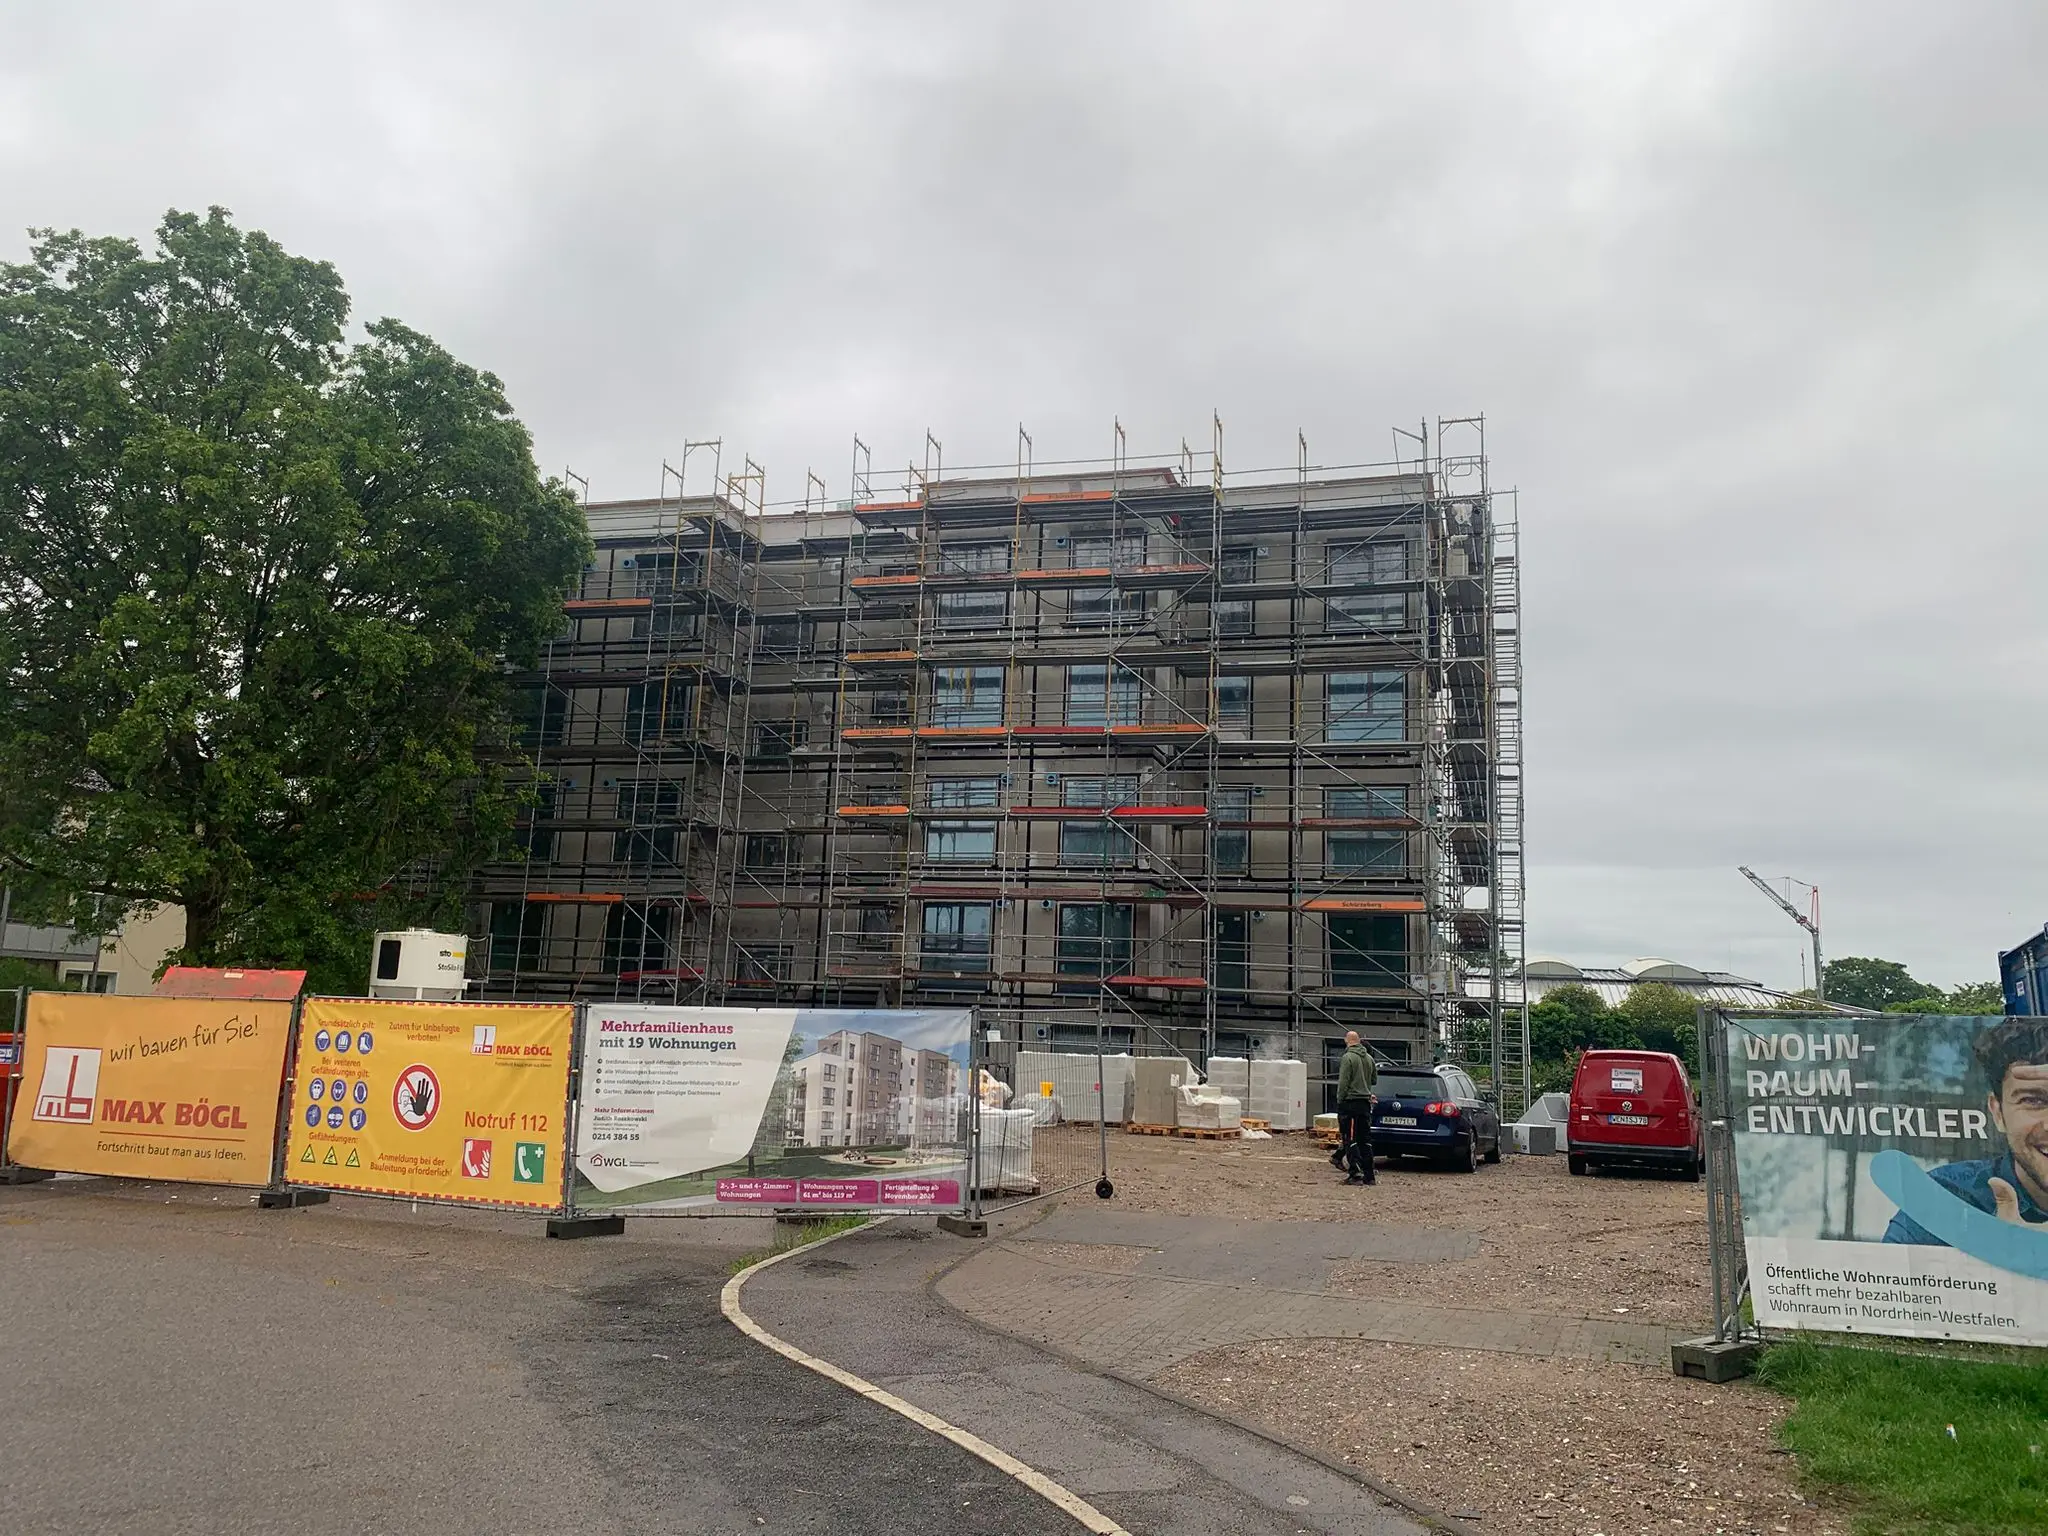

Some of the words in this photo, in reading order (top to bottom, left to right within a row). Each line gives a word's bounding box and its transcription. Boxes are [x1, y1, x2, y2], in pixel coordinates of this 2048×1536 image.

[411, 1022, 422, 1031] für
[423, 1024, 461, 1035] Unbefugte
[600, 1020, 734, 1035] Mehrfamilienhaus
[110, 1043, 135, 1062] wir
[139, 1036, 187, 1057] bauen
[193, 1024, 220, 1046] für
[224, 1015, 258, 1043] Sie!
[407, 1033, 441, 1041] verboten!
[599, 1036, 625, 1048] mit
[627, 1036, 645, 1049] 19
[648, 1037, 737, 1053] Wohnungen
[496, 1045, 521, 1055] MAX
[523, 1043, 552, 1056] BÖGL
[1743, 1033, 1876, 1062] WOHN-
[1747, 1068, 1869, 1097] RAUM-
[101, 1099, 167, 1125] MAX
[174, 1098, 248, 1129] BÖGL
[464, 1111, 516, 1130] Notruf
[521, 1114, 547, 1132] 112
[1749, 1105, 1988, 1140] ENTWICKLER
[613, 1133, 628, 1141] 384
[97, 1141, 145, 1154] Fortschritt
[147, 1143, 169, 1156] baut
[171, 1148, 192, 1157] man
[194, 1149, 211, 1159] aus
[214, 1149, 246, 1161] Ideen.
[378, 1153, 418, 1165] Anmeldung
[419, 1155, 431, 1165] bei
[432, 1157, 446, 1166] der
[370, 1161, 407, 1175] Bauleitung
[407, 1166, 453, 1177] erforderlich!
[603, 1157, 628, 1167] WGL
[720, 1190, 761, 1199] Wohnungen
[803, 1183, 844, 1191] Wohnungen
[1766, 1262, 1840, 1282] Öffentliche
[1843, 1270, 1997, 1295] Wohnraumförderung
[1768, 1284, 1812, 1297] schafft
[1816, 1287, 1852, 1300] mehr
[1856, 1287, 1942, 1305] bezahlbaren
[1769, 1299, 1841, 1316] Wohnraum
[1845, 1303, 1858, 1317] in
[1862, 1305, 2020, 1328] Nordrhein-Westfalen.
